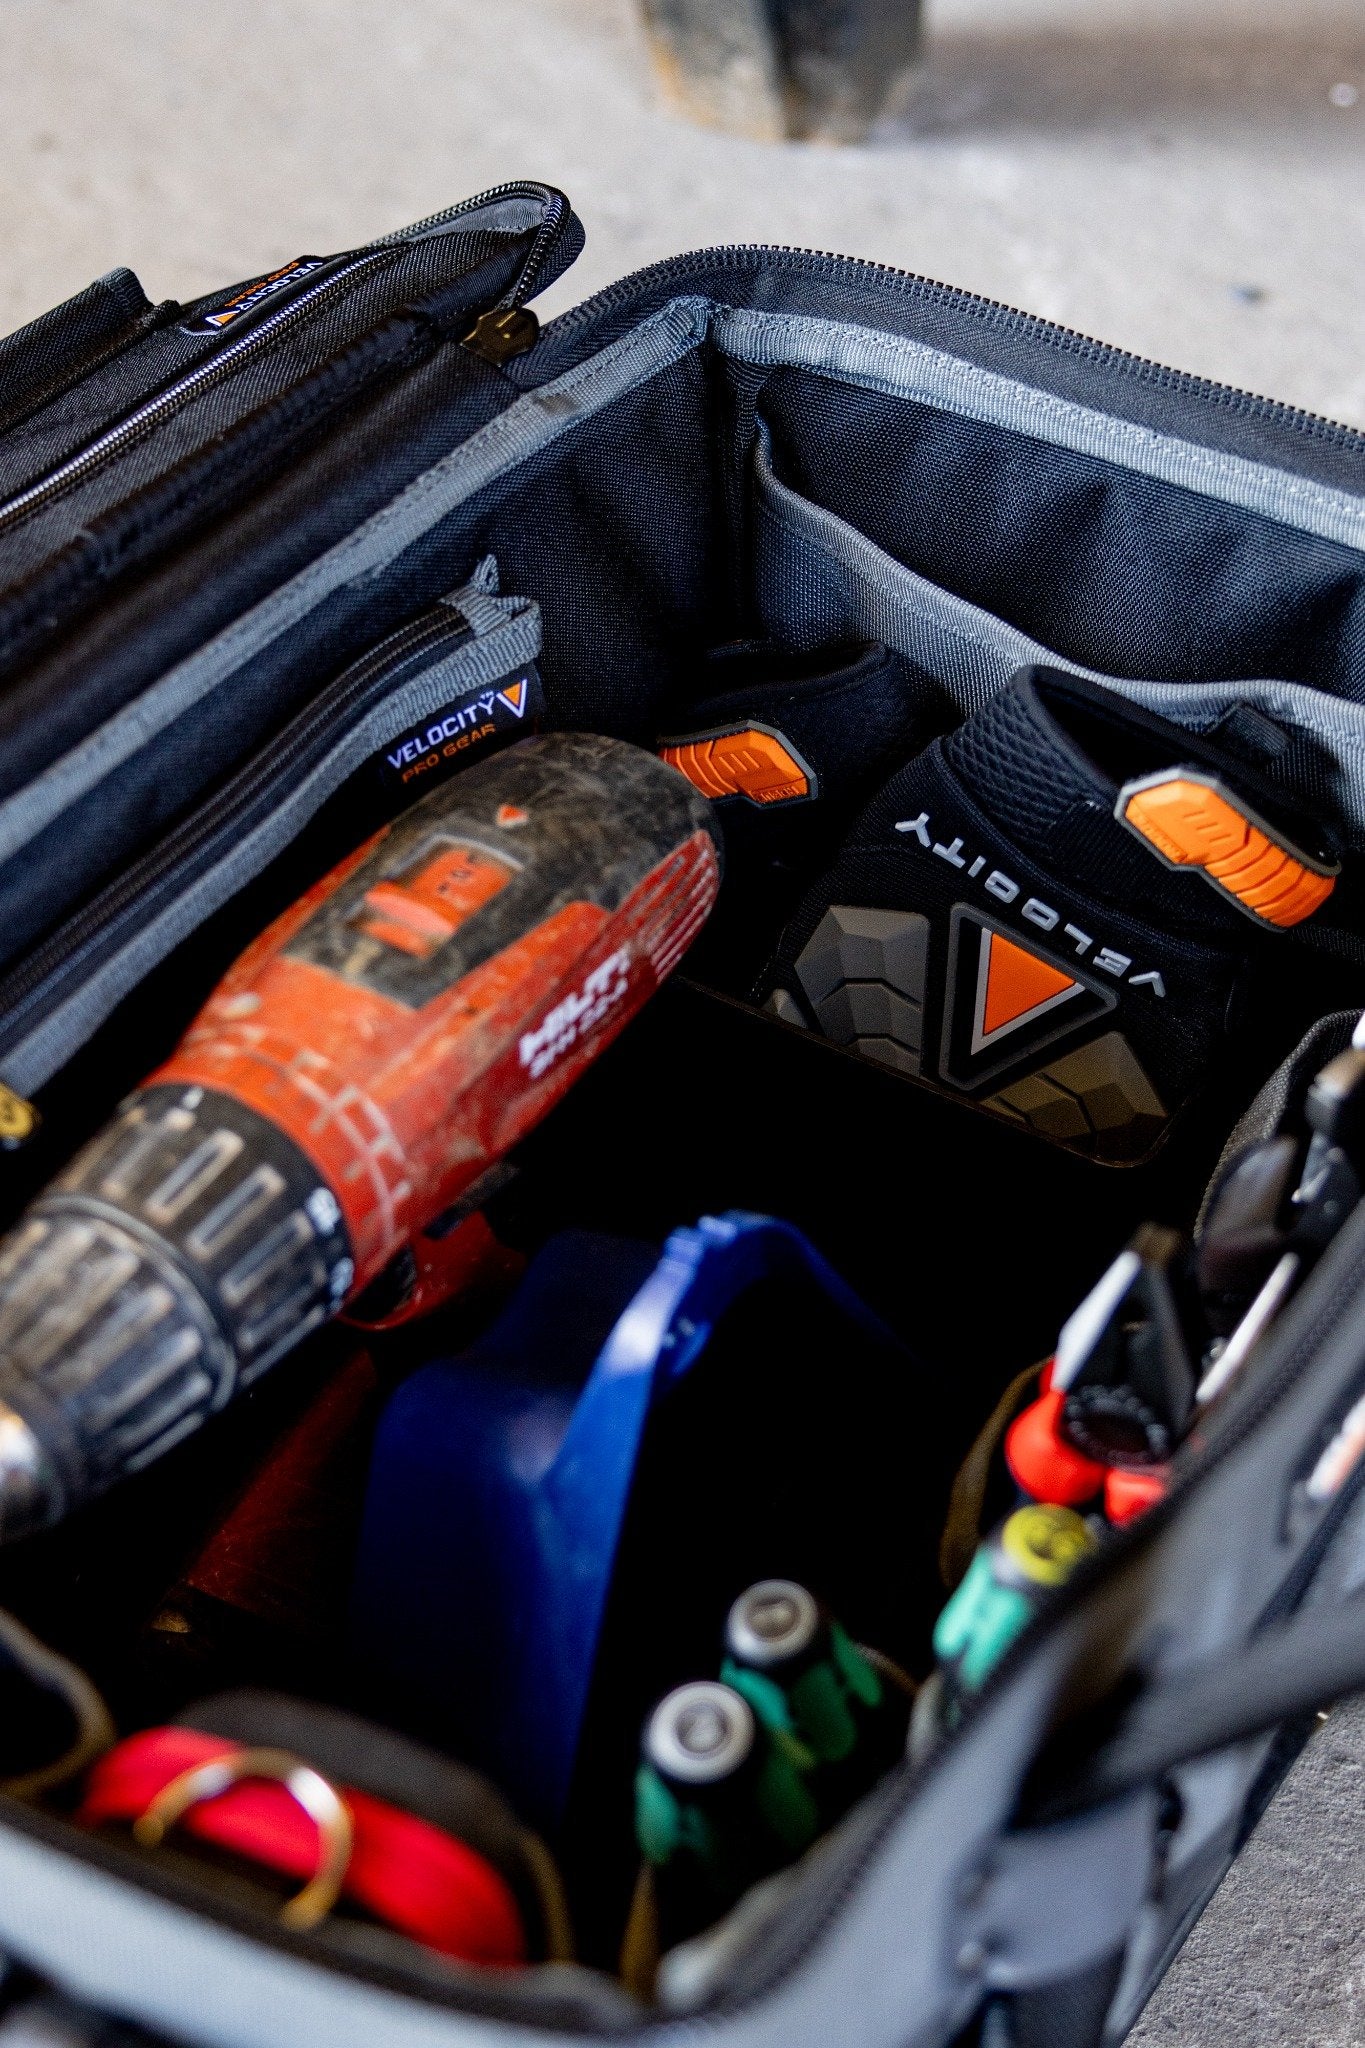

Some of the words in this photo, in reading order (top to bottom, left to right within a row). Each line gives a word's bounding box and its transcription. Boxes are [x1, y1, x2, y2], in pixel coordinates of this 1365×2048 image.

[236, 262, 323, 311] VELOCITY
[387, 693, 496, 769] VELOCITY
[402, 752, 440, 784] PRO
[443, 723, 497, 757] GEAR
[895, 812, 1166, 998] VELOCITY
